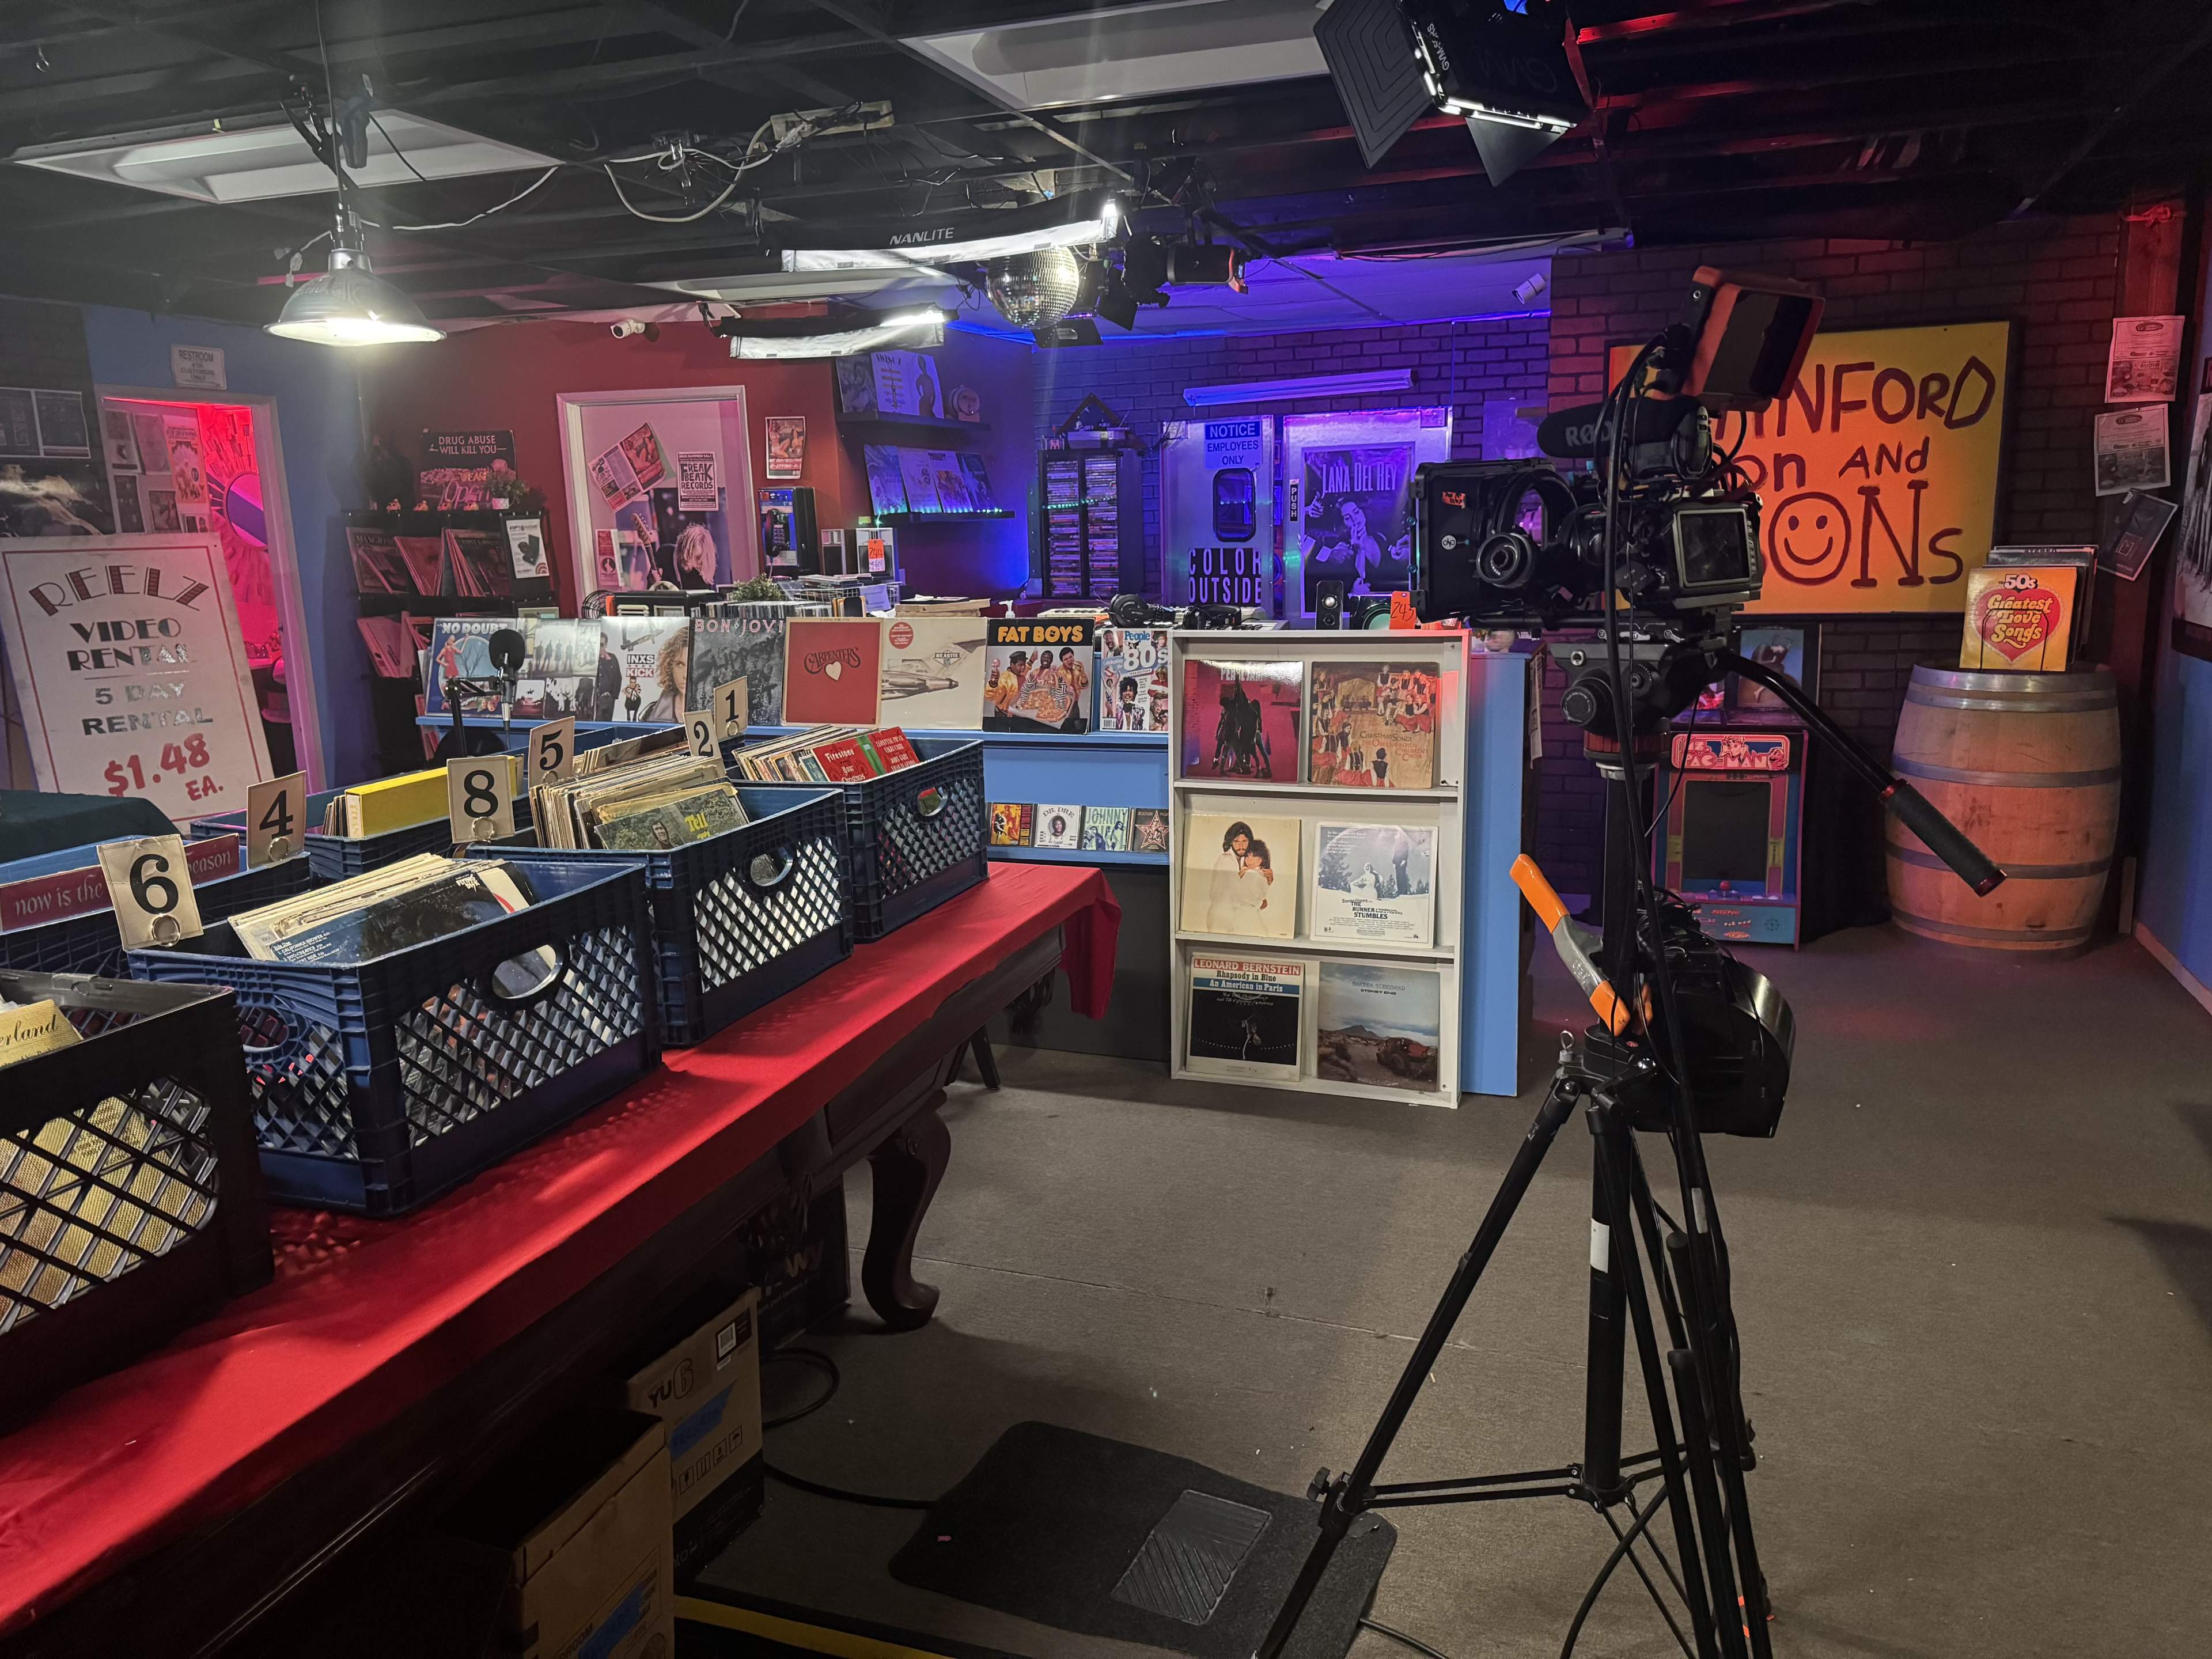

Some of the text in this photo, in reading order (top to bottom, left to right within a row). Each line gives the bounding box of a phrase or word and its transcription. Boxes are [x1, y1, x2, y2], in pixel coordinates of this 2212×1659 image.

[889, 227, 955, 245] NANLITE
[178, 349, 214, 362] RESTROOM
[1210, 423, 1256, 438] NOTICE
[438, 435, 496, 445] DRUG ABUSE
[1207, 440, 1259, 452] EMPLOYEES
[440, 445, 497, 454] WILL KILL YOU
[1222, 454, 1244, 465] ONLY
[680, 463, 713, 482] FREAK
[684, 472, 705, 482] BEAT
[1323, 462, 1397, 493] LANA DEL REY
[1732, 452, 1806, 492] on
[681, 482, 713, 490] RECORDS
[1190, 549, 1261, 575] COLOR
[29, 565, 209, 616] REELZ
[1189, 577, 1261, 604] OUTSIDE
[2003, 573, 2039, 590] 50s
[1987, 594, 2054, 615] Greatest
[1996, 609, 2041, 624] Love
[70, 618, 181, 644] VIDEO
[442, 623, 461, 634] NO
[695, 619, 783, 638] BON JOVI
[998, 625, 1083, 643] FAT BOYS
[1124, 630, 1150, 642] People
[1990, 623, 2043, 643] Songs
[67, 643, 197, 671] RENTAL
[627, 654, 654, 664] INXS
[804, 647, 861, 675] CARPENTERS
[1123, 646, 1168, 671] 80s
[627, 668, 654, 677] KICK
[1221, 667, 1245, 681] PEAL
[96, 681, 185, 704] 5 DAY
[725, 690, 739, 722] 1
[82, 708, 213, 734] RENTAL
[694, 721, 713, 756] 2
[1392, 734, 1413, 742] SONGS
[540, 729, 563, 770] 5
[824, 749, 854, 763] Firestone
[104, 733, 210, 797] $1.48
[842, 765, 854, 774] Your
[842, 774, 865, 782] Christmas
[185, 775, 224, 801] EA.
[464, 770, 498, 818] 8
[259, 790, 293, 838] 4
[1043, 808, 1056, 817] DR.
[1058, 807, 1075, 817] DRE
[1086, 808, 1127, 824] JOHNNY
[684, 811, 709, 832] Tell
[14, 849, 232, 917] now is the eason
[130, 854, 179, 915] 6
[281, 941, 306, 953] CALIFORNIA
[306, 934, 323, 945] SHOWER
[1194, 959, 1300, 975] LEONARD BERNSTEIN
[1217, 971, 1250, 981] Rhapsody
[1221, 980, 1253, 990] American
[1264, 984, 1283, 993] Paris
